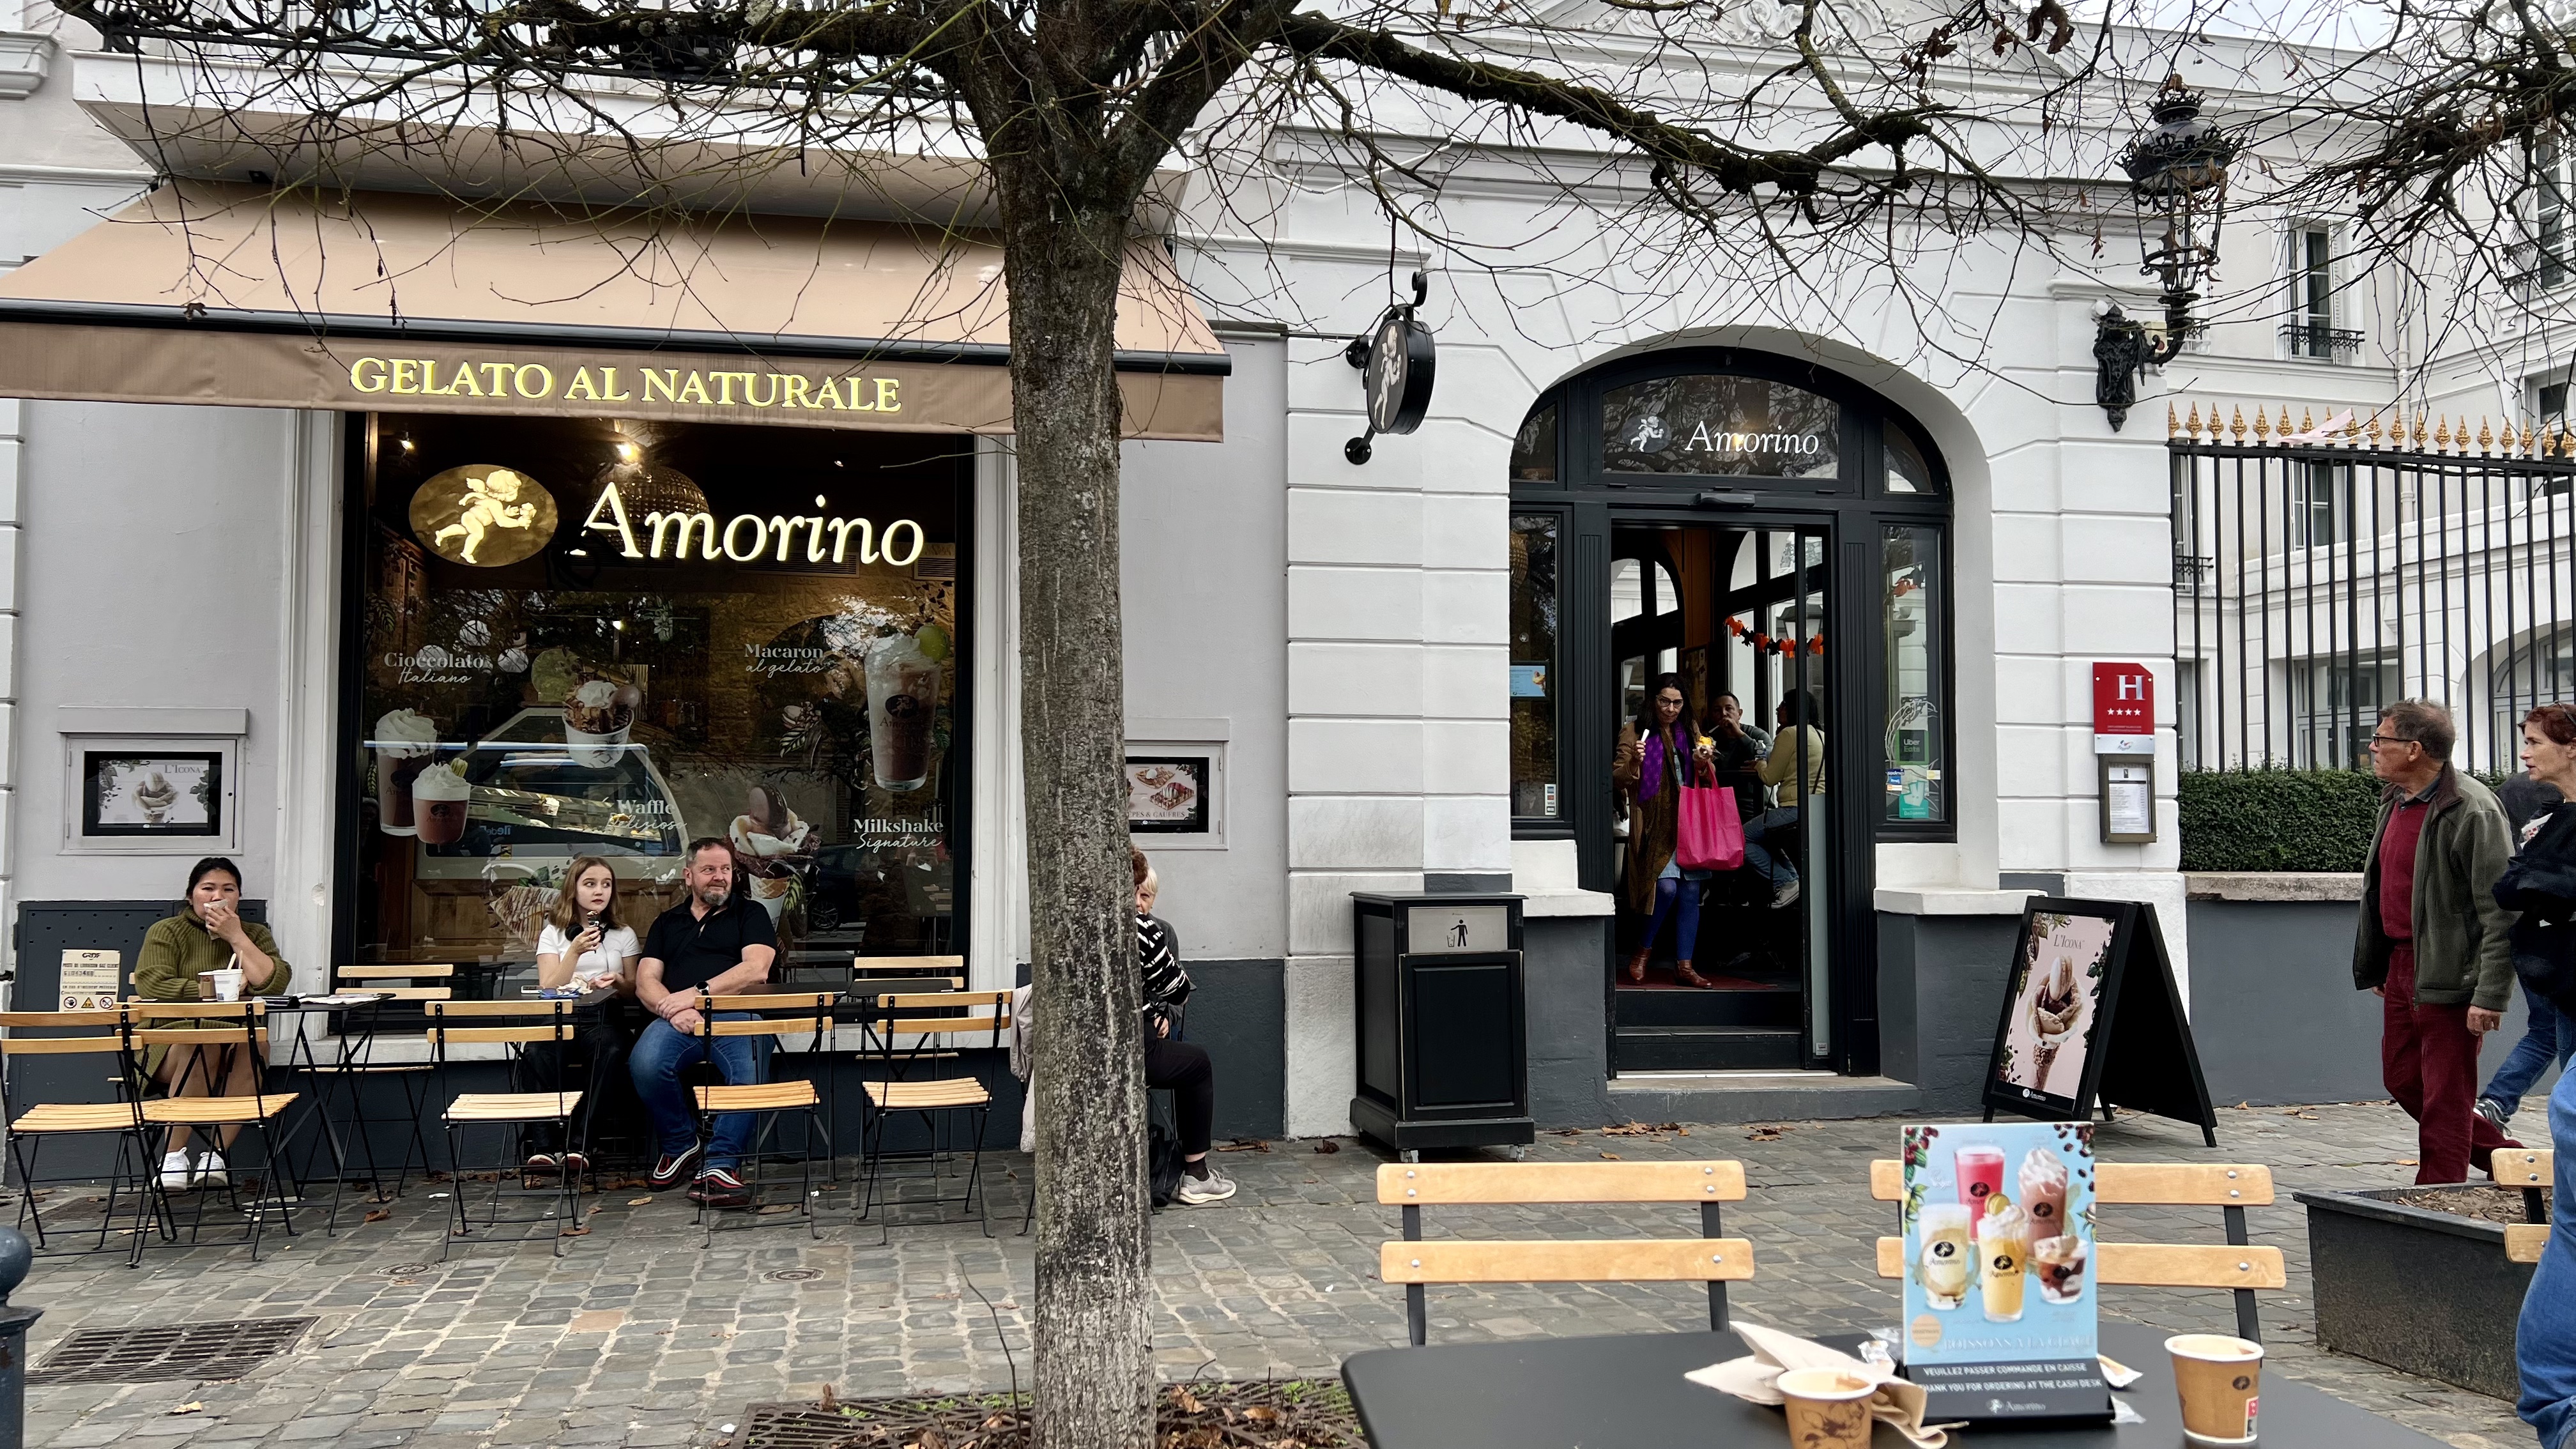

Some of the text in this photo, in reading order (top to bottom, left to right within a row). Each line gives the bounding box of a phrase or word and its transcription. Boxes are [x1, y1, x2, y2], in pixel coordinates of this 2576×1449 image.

[350, 356, 901, 412] GELATO AL NATURALE
[1684, 419, 1820, 455] Amorino
[565, 478, 924, 566] Amorino
[744, 643, 824, 659] Macaron
[384, 652, 484, 668] Cioccolato
[397, 668, 473, 685] Italiano
[746, 659, 824, 679] al gelato
[2116, 675, 2145, 700] H
[617, 799, 675, 815] Waffle
[853, 818, 944, 833] Milkshake
[855, 832, 942, 854] Signature
[1922, 1366, 1963, 1376] VEUILLEZ
[1963, 1365, 1996, 1375] PASSER
[1996, 1363, 2044, 1374] COMMANDE
[2057, 1363, 2087, 1372] CAISSE
[1948, 1383, 1965, 1392] YOU
[1965, 1383, 1983, 1392] FOR
[1983, 1381, 2026, 1391] ORDERING
[2027, 1380, 2037, 1389] AT
[2038, 1379, 2056, 1389] THE
[2056, 1379, 2079, 1388] CASH
[2079, 1378, 2103, 1388] DESK
